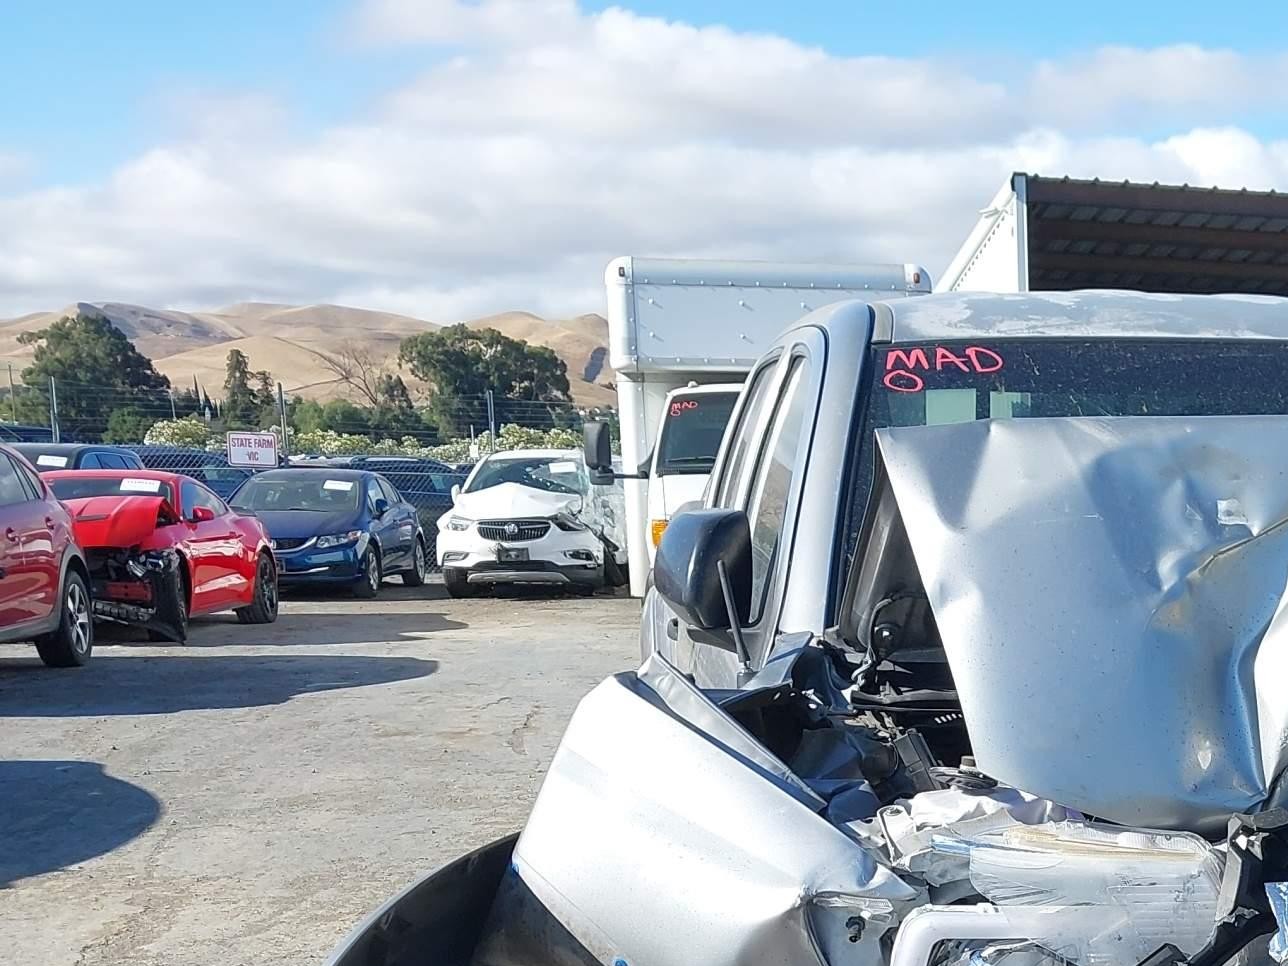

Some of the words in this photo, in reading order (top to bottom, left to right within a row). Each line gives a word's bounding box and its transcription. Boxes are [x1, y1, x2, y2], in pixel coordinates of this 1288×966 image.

[886, 346, 1003, 373] MAD
[671, 401, 698, 411] MAD
[231, 437, 252, 448] STATE
[253, 438, 274, 449] FARM
